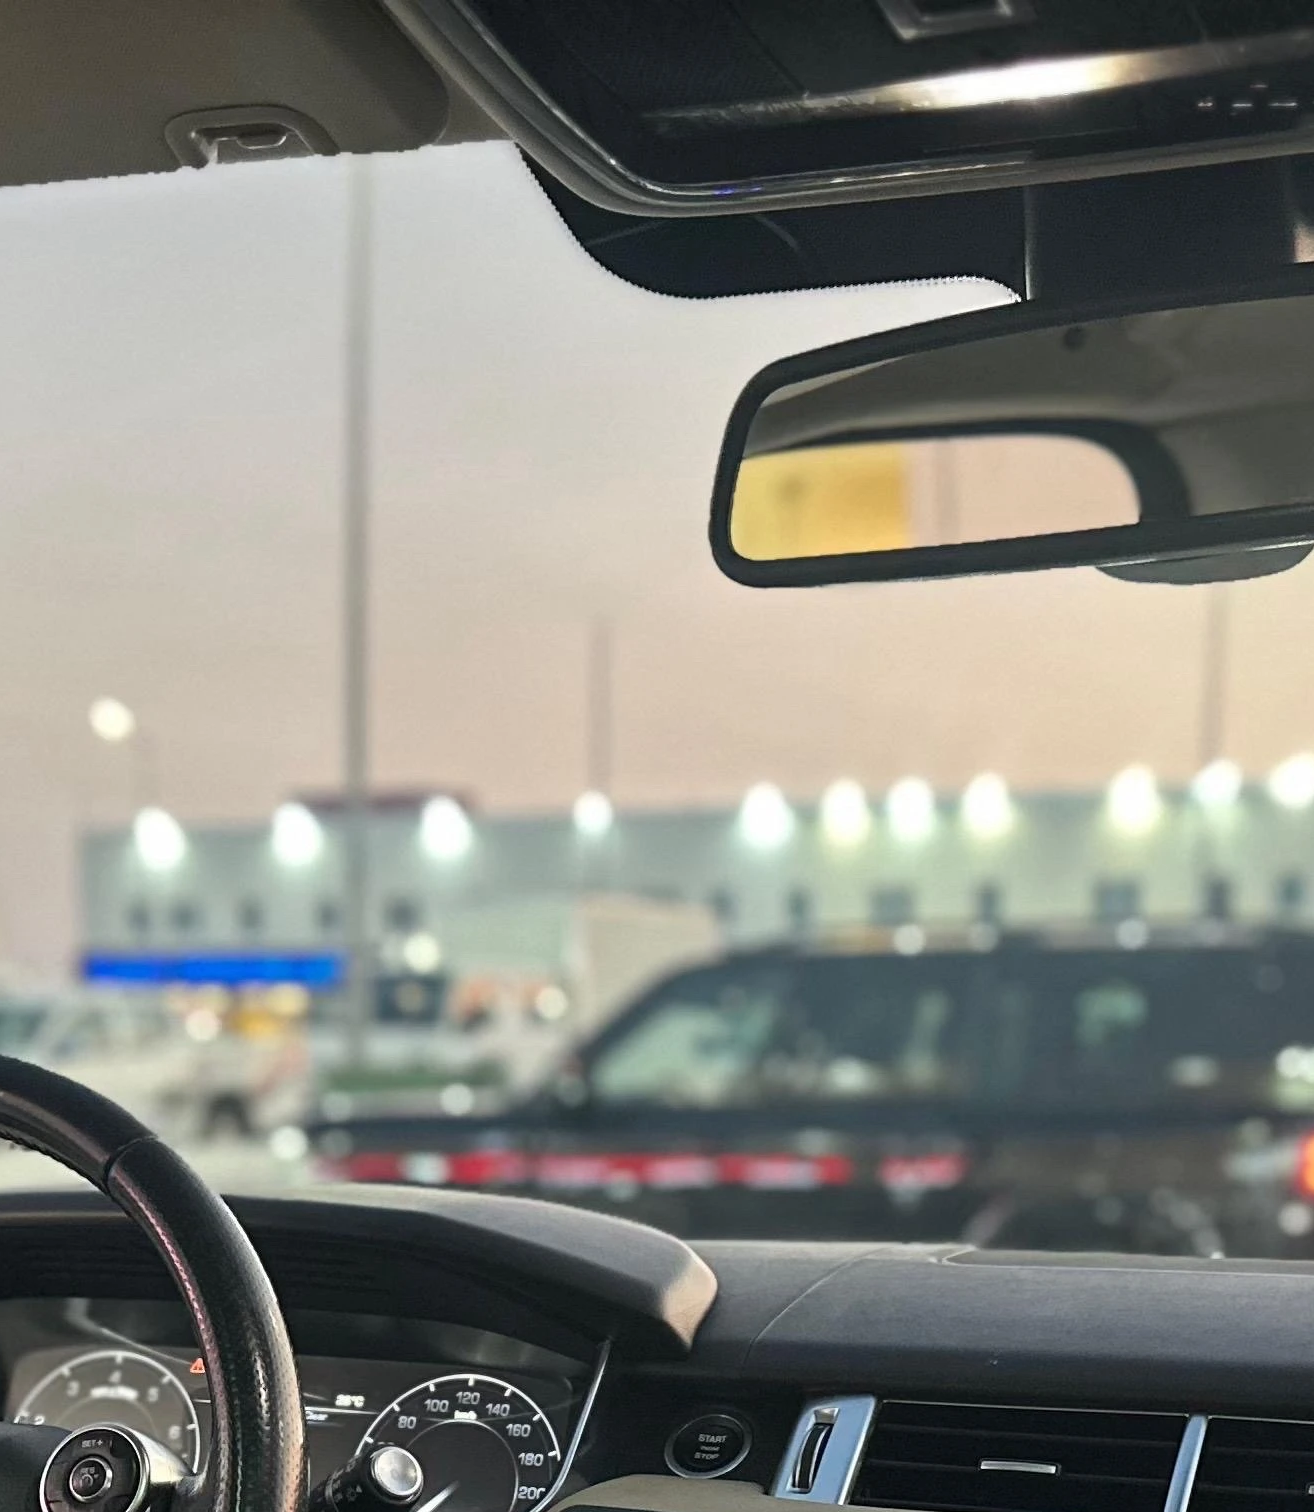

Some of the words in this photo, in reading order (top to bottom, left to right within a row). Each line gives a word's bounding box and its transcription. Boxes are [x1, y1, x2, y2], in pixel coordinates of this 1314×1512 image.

[455, 1391, 480, 1405] 120
[424, 1399, 449, 1413] 100
[486, 1403, 511, 1417] 140
[397, 1416, 417, 1430] 80
[505, 1423, 532, 1437] 160
[698, 1433, 727, 1443] START
[517, 1452, 544, 1467] 180
[694, 1452, 720, 1460] STOP
